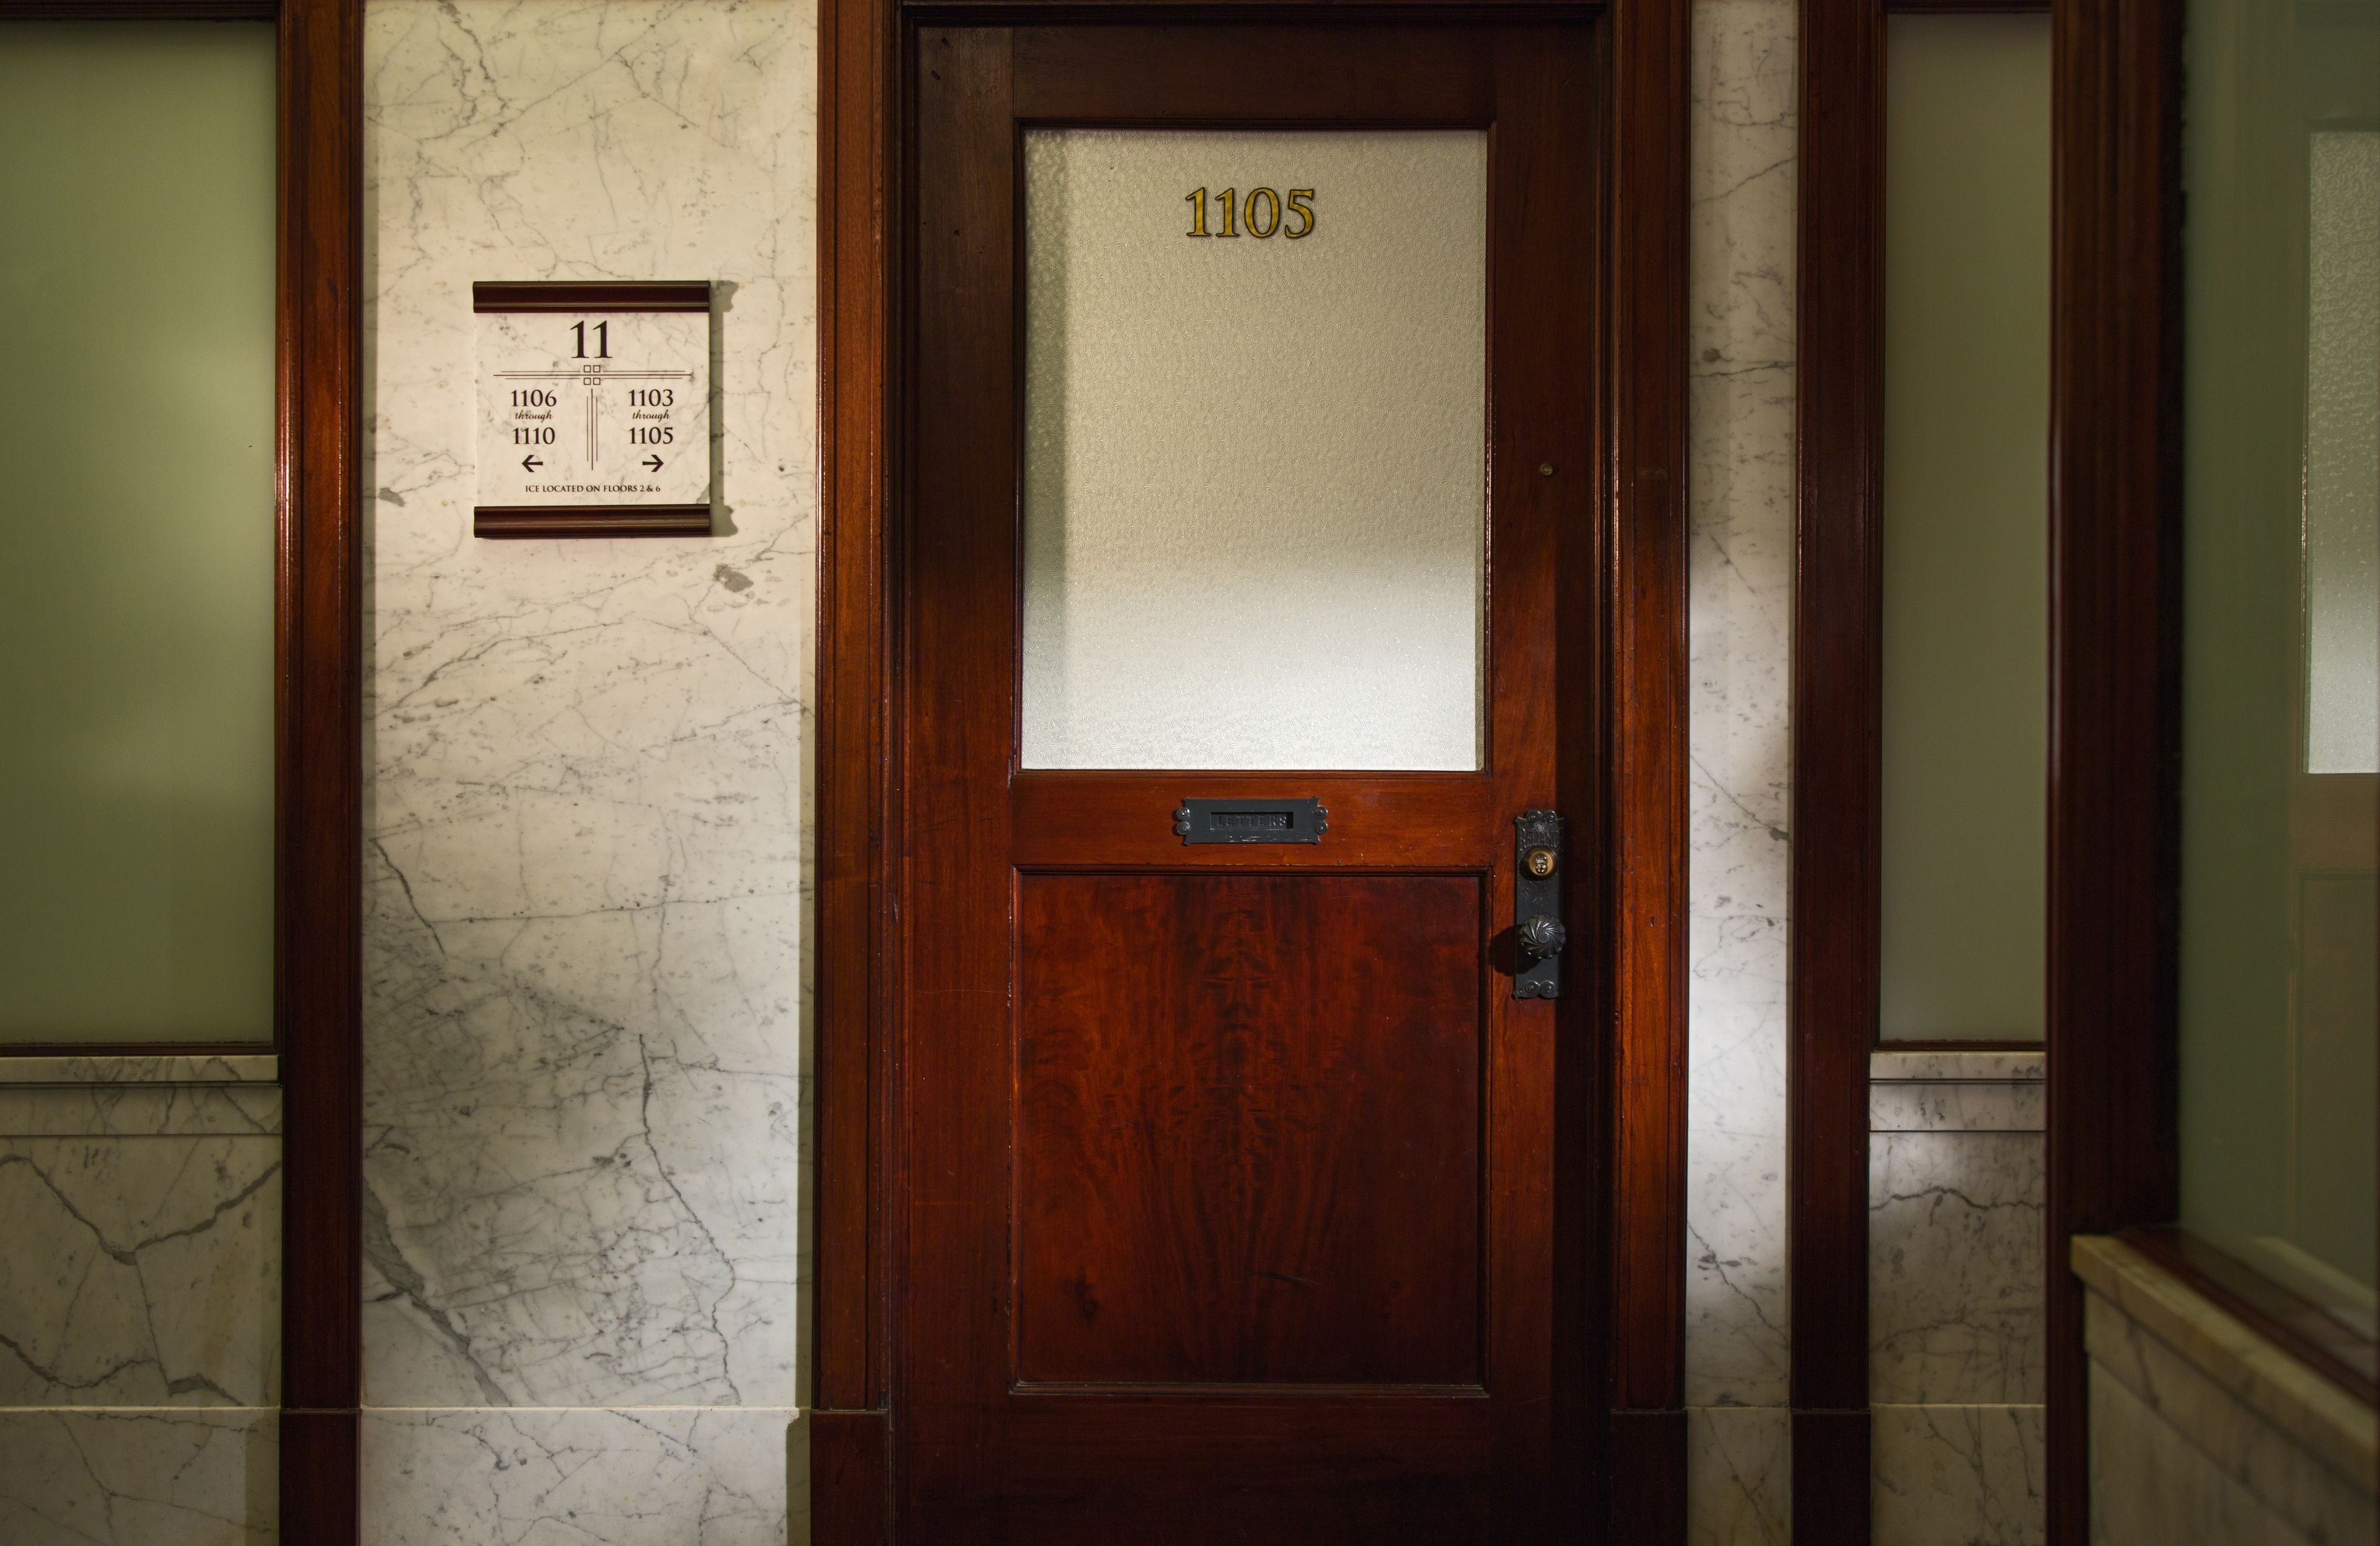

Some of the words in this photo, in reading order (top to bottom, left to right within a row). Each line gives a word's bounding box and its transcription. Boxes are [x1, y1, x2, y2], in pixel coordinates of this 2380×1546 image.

[1185, 187, 1315, 239] 1105
[570, 320, 613, 359] 11
[510, 389, 557, 407] 1106
[628, 389, 674, 407] 1103
[514, 410, 553, 423] through
[632, 410, 671, 423] through
[513, 426, 555, 445] 1110
[628, 426, 674, 445] 1105
[526, 485, 540, 493] ICE
[542, 485, 584, 493] LOCATED
[586, 485, 601, 493] ON
[603, 485, 638, 493] FLOORS
[640, 485, 645, 493] 2
[646, 485, 653, 493] &
[655, 485, 661, 493] 6
[1216, 814, 1287, 827] LETTERS
